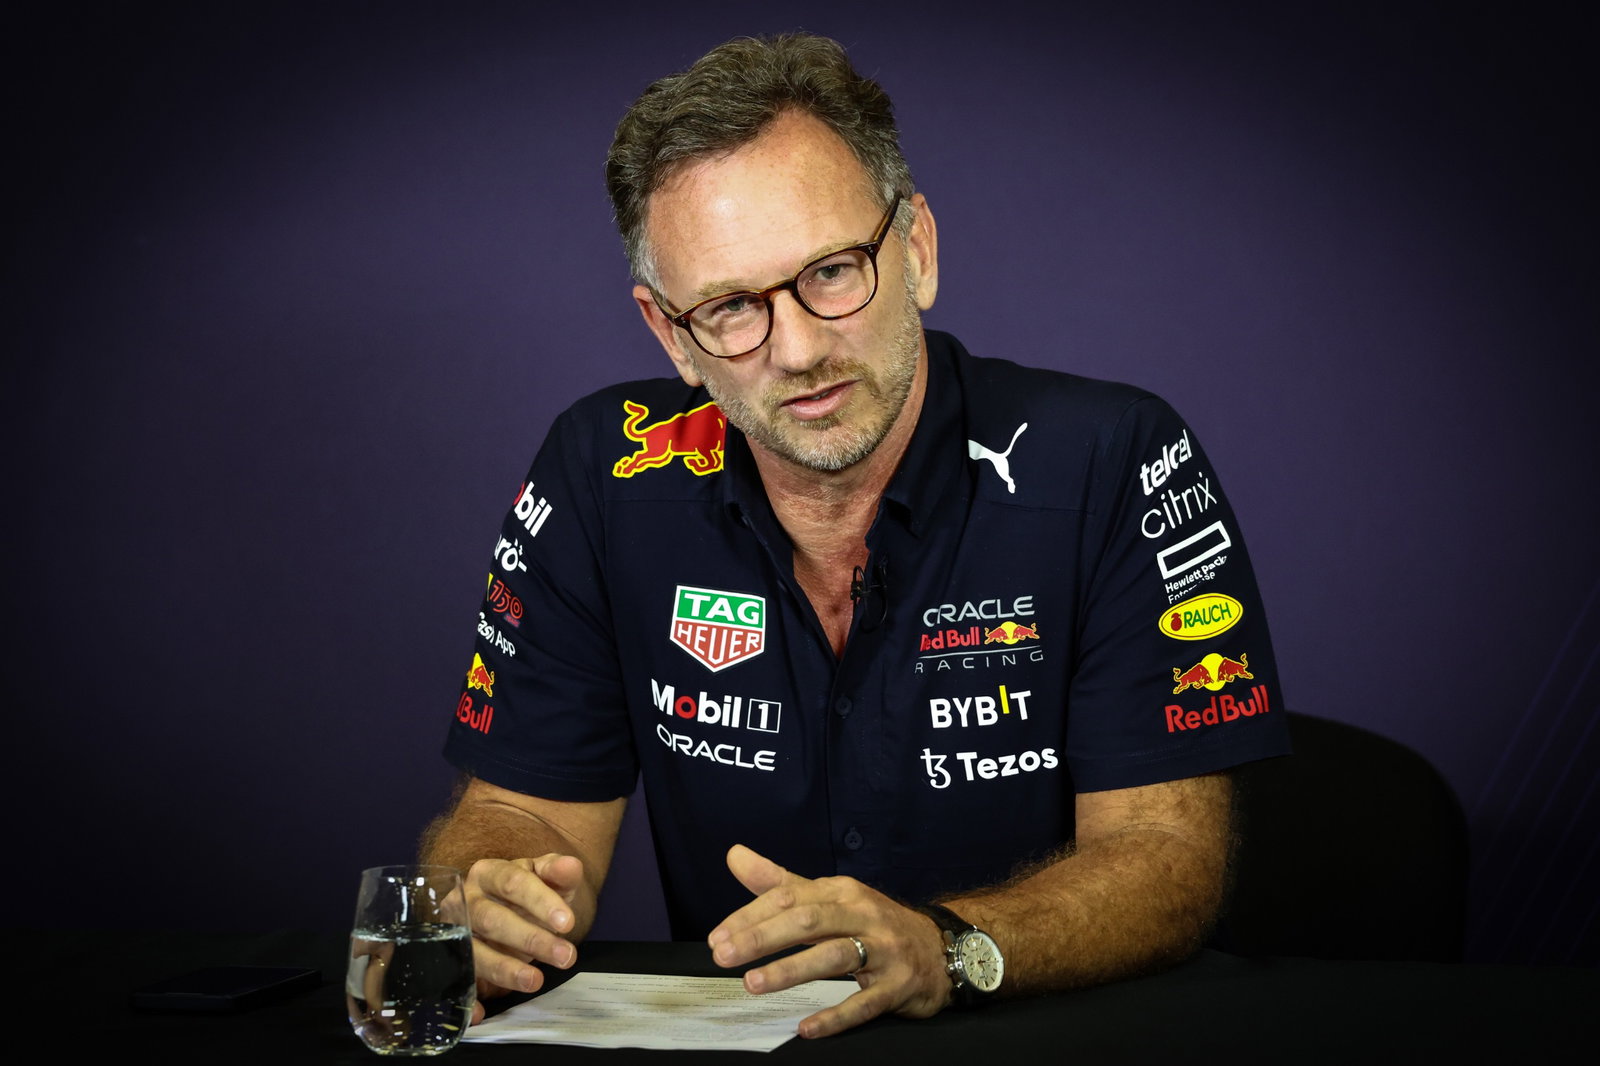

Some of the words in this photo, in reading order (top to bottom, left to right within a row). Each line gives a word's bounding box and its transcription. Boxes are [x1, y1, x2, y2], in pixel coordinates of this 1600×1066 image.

[1139, 428, 1193, 496] telcel
[513, 481, 553, 538] bil
[1141, 471, 1218, 539] citrix
[1164, 569, 1203, 594] Hewlett
[1200, 555, 1227, 575] Pack
[684, 592, 760, 625] TAG
[922, 595, 1035, 627] ORACLE
[1184, 602, 1232, 629] RAUCH
[495, 630, 516, 657] App
[676, 623, 760, 666] HEUER
[946, 626, 980, 648] Bull
[914, 649, 1044, 674] RACING
[458, 695, 494, 735] Bull
[651, 678, 742, 728] Mobil
[929, 684, 1032, 729] BYBIT
[1165, 696, 1219, 733] Red
[1219, 684, 1270, 723] Bull
[656, 723, 777, 772] ORACLE
[956, 748, 1059, 781] Tezos
